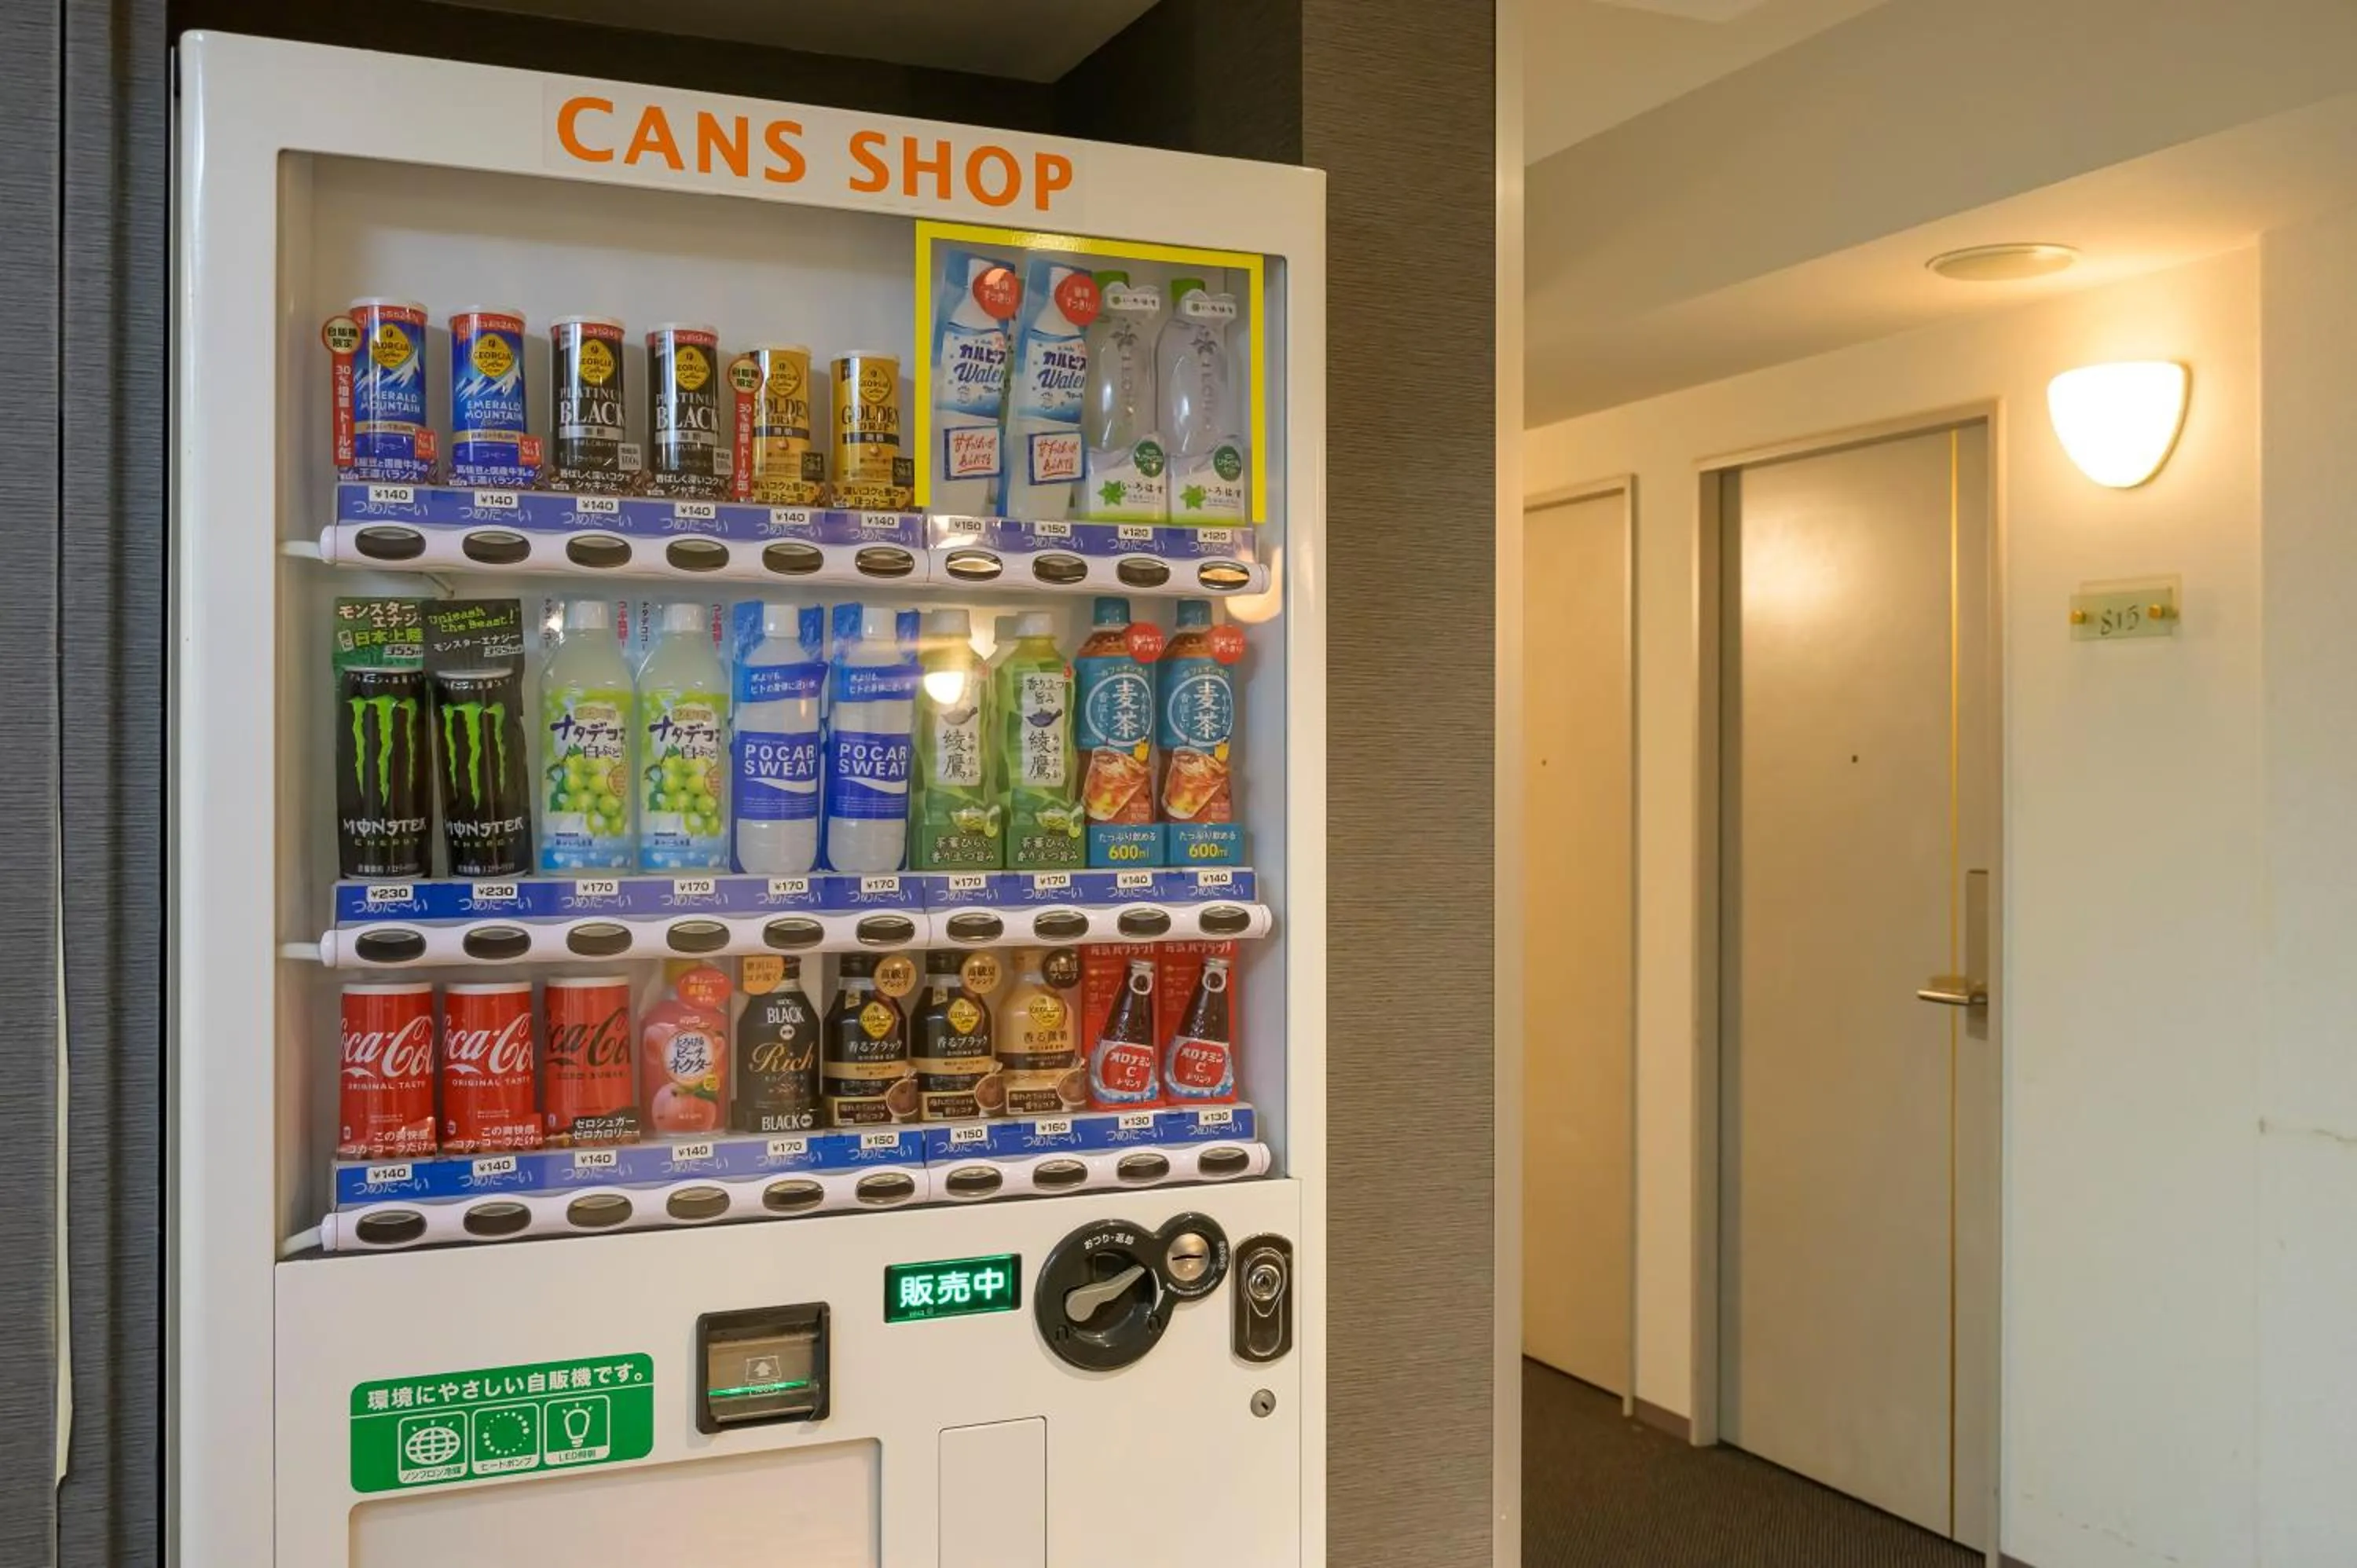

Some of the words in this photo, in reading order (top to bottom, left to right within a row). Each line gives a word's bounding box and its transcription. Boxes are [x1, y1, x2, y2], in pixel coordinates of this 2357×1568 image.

[557, 97, 806, 183] CANS
[849, 130, 1073, 211] SHOP
[959, 343, 1006, 365] カルピス
[1043, 350, 1087, 372] カルピス
[362, 390, 418, 403] EMERALD
[361, 401, 420, 413] MOUNTAIN
[467, 400, 520, 412] EMERALD
[464, 409, 522, 421] MOUNTAIN
[375, 489, 408, 500] ¥140
[481, 494, 513, 505] ¥140
[582, 500, 614, 511] ¥140
[680, 505, 711, 516] ¥140
[775, 512, 805, 522] ¥140
[867, 515, 895, 526] ¥140
[955, 521, 981, 531] ¥150
[1041, 524, 1067, 534] ¥150
[1123, 527, 1149, 537] ¥120
[1202, 530, 1226, 540] ¥120
[339, 601, 416, 619] モンスター
[433, 633, 521, 652] モンスターエナジー
[1113, 679, 1140, 739] 麦茶
[1193, 680, 1221, 740] 麦茶
[584, 744, 625, 759] 白ぶど
[681, 744, 718, 760] 白ぶど
[943, 728, 967, 779] 綾鷹
[1028, 730, 1052, 780] 綾鷹
[744, 759, 816, 776] SWEAT
[838, 758, 907, 776] SWEAT
[343, 817, 427, 837] MONSTER
[444, 816, 524, 837] MONSTER
[354, 837, 419, 848] ENERGY
[1099, 832, 1157, 842] たっぷり飲める
[1108, 844, 1149, 860] 600ml
[866, 878, 895, 890] ¥170
[955, 877, 981, 887] ¥170
[1039, 874, 1066, 885] ¥170
[1121, 875, 1149, 885] ¥140
[1203, 874, 1229, 883] ¥140
[478, 885, 515, 896] ¥230
[582, 882, 614, 892] ¥170
[679, 881, 709, 892] ¥170
[774, 879, 804, 891] ¥170
[370, 888, 408, 899] ¥230
[767, 1007, 805, 1024] BLACK
[676, 1046, 705, 1058] ピーチ
[748, 1042, 816, 1074] Rich
[1180, 1047, 1223, 1063] オロナミン
[1109, 1051, 1151, 1067] オロナミン
[671, 1058, 711, 1074] ネクター
[1126, 1066, 1137, 1077] C
[1196, 1061, 1207, 1072] C
[452, 1078, 500, 1087] ORIGINAL
[575, 1116, 636, 1129] ゼロシュガー
[761, 1112, 800, 1132] BLACK
[1124, 1116, 1149, 1127] ¥130
[1203, 1112, 1228, 1122] ¥130
[1041, 1122, 1068, 1131] ¥160
[867, 1134, 894, 1145] ¥150
[956, 1130, 983, 1139] ¥150
[678, 1146, 709, 1157] ¥140
[772, 1141, 802, 1152] ¥170
[581, 1153, 612, 1165] ¥140
[478, 1160, 511, 1171] ¥140
[373, 1168, 406, 1179] ¥140
[1083, 1233, 1135, 1250] おつり・返却
[900, 1267, 1004, 1308] 販売中
[367, 1363, 643, 1411] 環境にやさしい自販機です。
[479, 1457, 532, 1471] ヒートポンプ
[402, 1467, 462, 1482] ノンフロン冷媒
